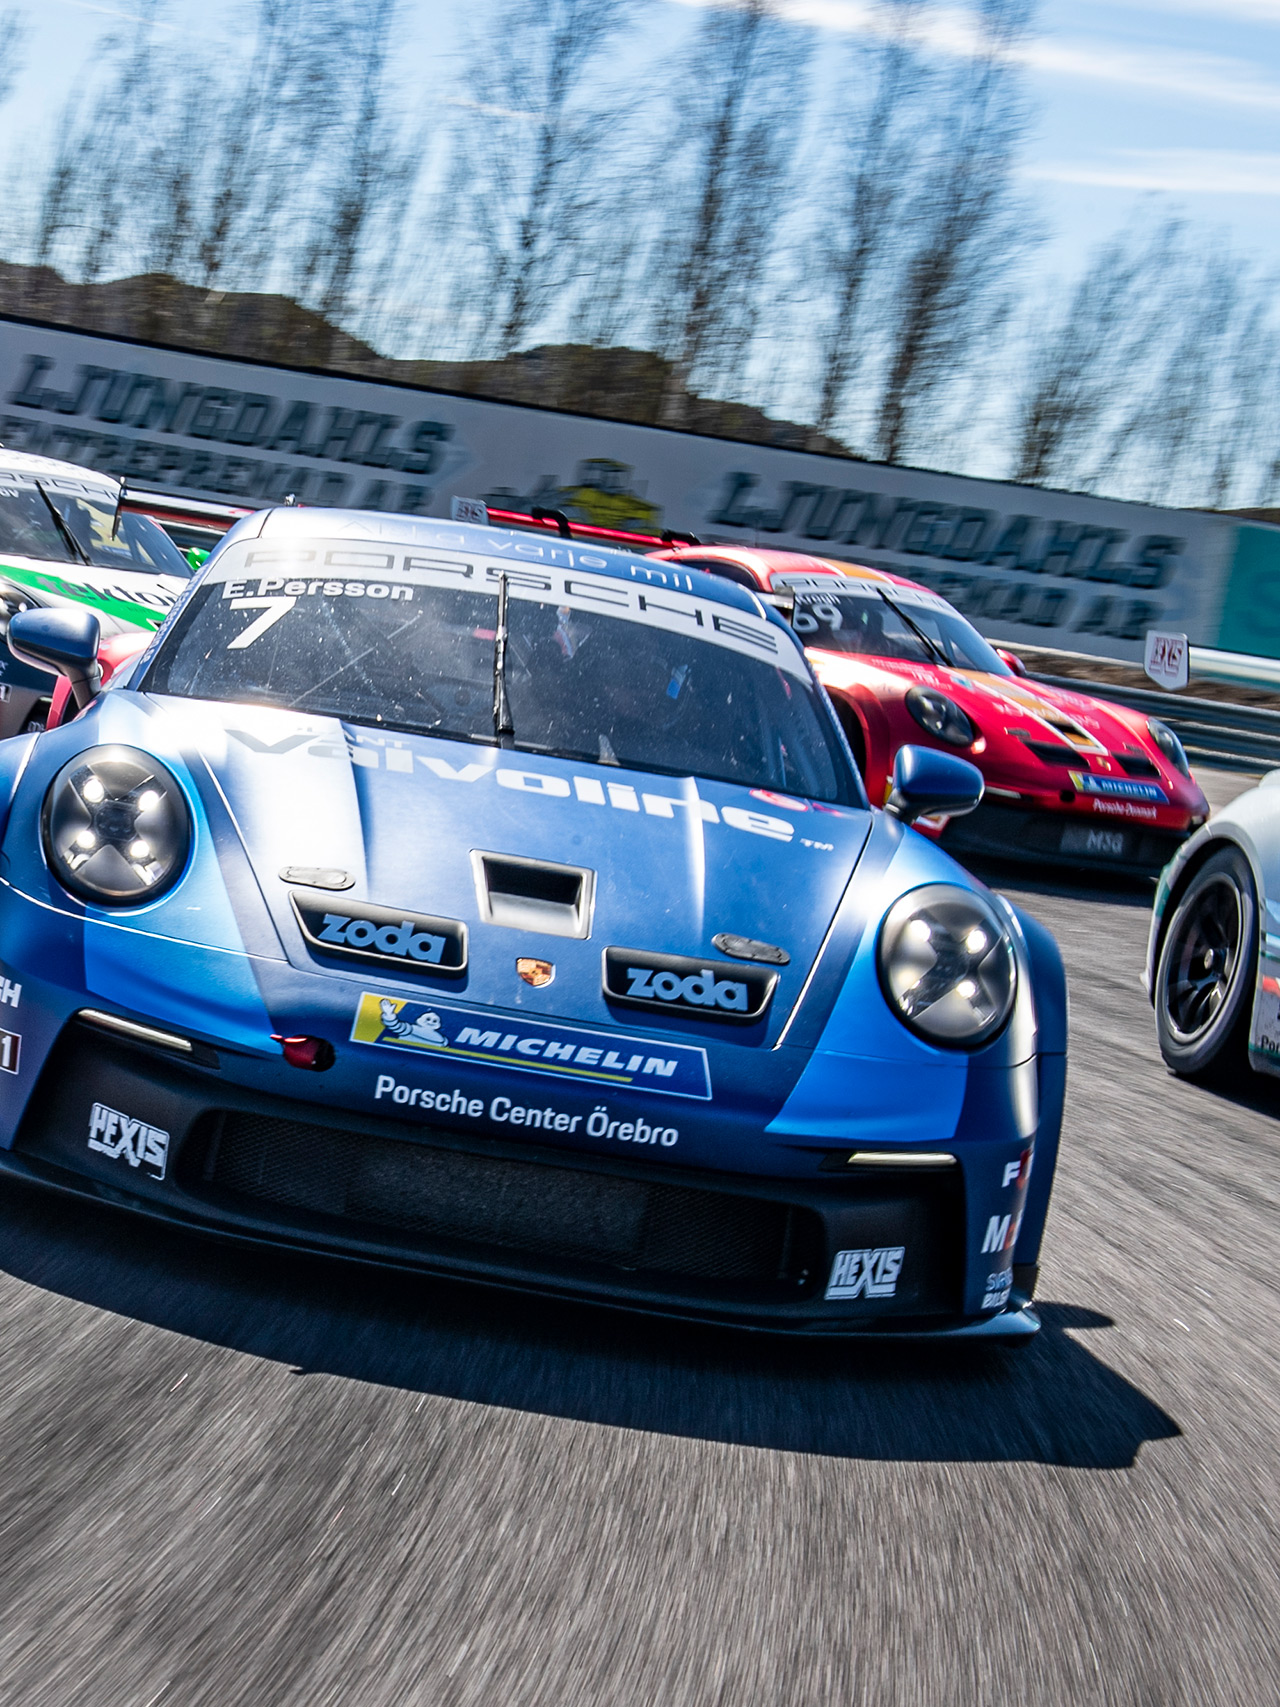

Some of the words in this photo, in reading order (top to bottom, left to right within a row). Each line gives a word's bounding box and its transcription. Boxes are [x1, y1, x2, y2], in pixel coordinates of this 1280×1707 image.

[7, 352, 455, 475] LJUNGDAHLS
[707, 470, 1188, 592] LJUNGDAHLS
[488, 538, 608, 569] varje
[630, 564, 694, 592] mil
[226, 598, 297, 650] 7
[244, 550, 779, 654] PORSCHE
[793, 602, 844, 634] 69
[224, 728, 795, 843] Valvoline
[1100, 780, 1158, 798] MICHELIN
[318, 913, 446, 963] zoda
[626, 968, 748, 1012] zoda
[454, 1026, 680, 1078] MICHELIN
[88, 1103, 170, 1172] HEXIS
[374, 1074, 485, 1118] Porsche
[489, 1096, 583, 1134] Center
[586, 1105, 680, 1148] Örebro
[827, 1248, 905, 1298] HEXIS
